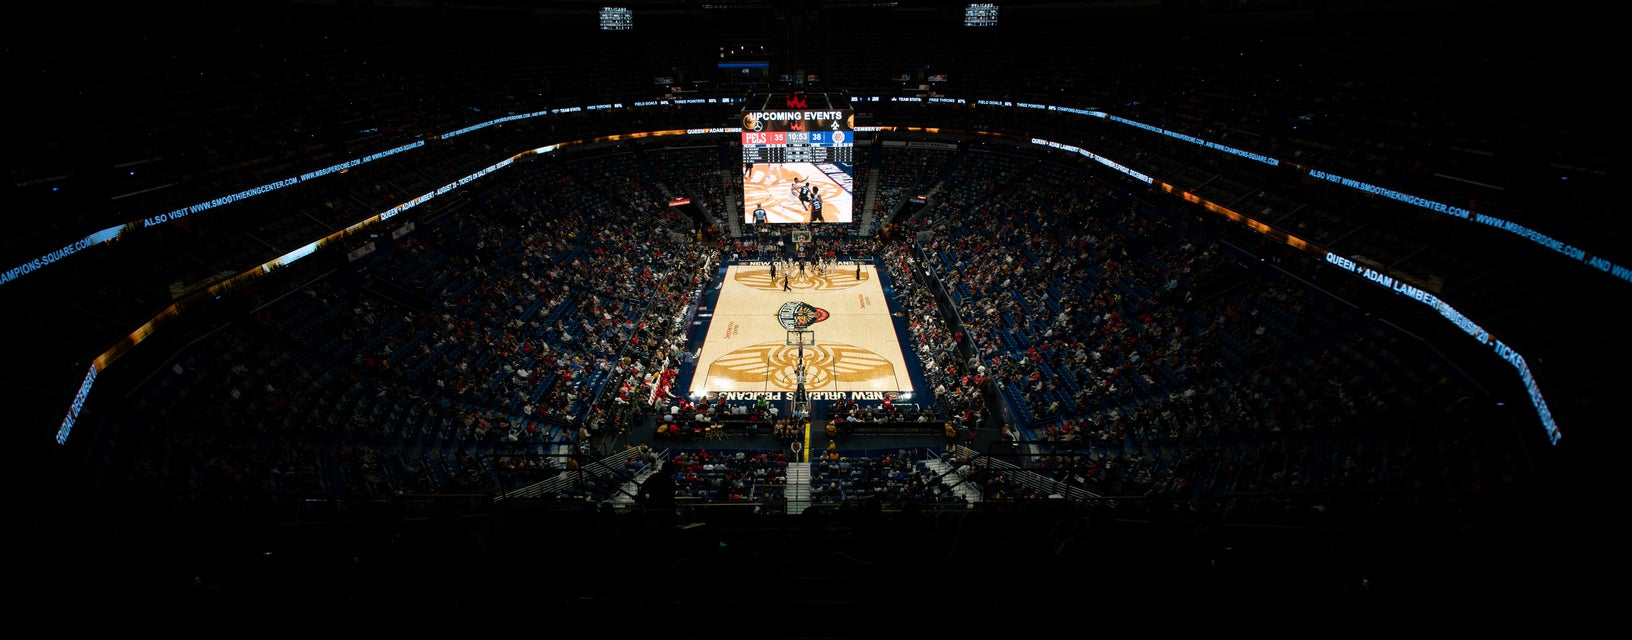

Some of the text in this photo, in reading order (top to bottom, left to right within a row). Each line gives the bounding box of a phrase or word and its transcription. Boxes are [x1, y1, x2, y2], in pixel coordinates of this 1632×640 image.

[749, 111, 842, 121] UPCOMING EVENTS
[746, 133, 766, 144] PELS
[1031, 138, 1046, 146] QUEEN
[1049, 141, 1060, 149] ADAM
[144, 214, 167, 227] ALSO
[168, 207, 189, 220] VISIT
[189, 177, 298, 213] WWW.SMOOTHIEKINGCENTER.COM
[380, 207, 398, 221] QUEEN
[402, 199, 415, 211] ADAM
[415, 191, 435, 205] LAMBERT
[1308, 169, 1325, 179] ALSO
[1326, 173, 1342, 183] VISIT
[1341, 177, 1470, 219] WWW.SMOOTHIEKINGCENTER.COM
[1475, 213, 1586, 262] WWW.MBSUPERDOME.COM
[1589, 256, 1611, 272] AND
[1326, 252, 1356, 272] QUEEN
[1363, 269, 1393, 289] ADAM
[1393, 281, 1441, 310] LAMBERT
[1445, 307, 1478, 336] AUGUST
[1476, 329, 1489, 344] 20
[72, 372, 94, 418] DECEMBER
[718, 392, 883, 401] NEW ORLEAS PELICANS
